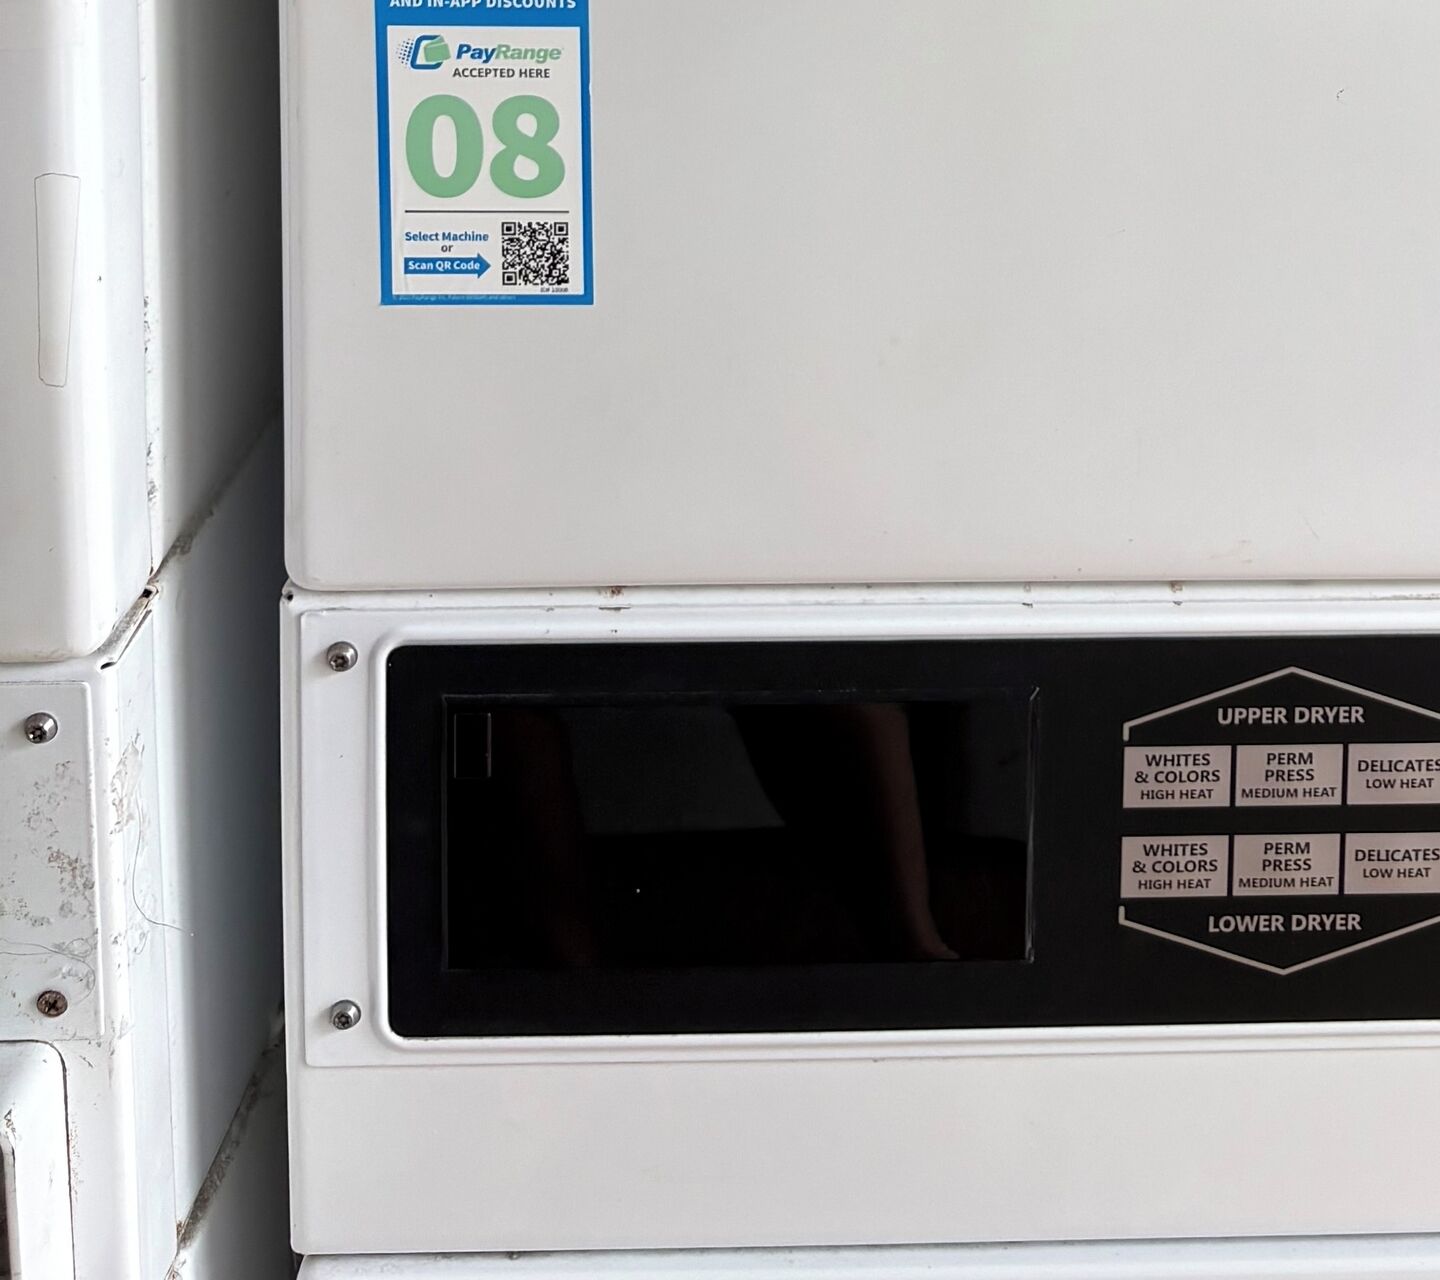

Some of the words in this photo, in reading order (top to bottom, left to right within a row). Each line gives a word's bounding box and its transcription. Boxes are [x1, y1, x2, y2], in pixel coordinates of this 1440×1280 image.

[456, 43, 562, 64] PayRange
[453, 68, 515, 78] ACCEPTED
[519, 68, 550, 79] HERE
[405, 94, 566, 198] 08
[405, 231, 439, 242] Select
[442, 232, 489, 242] Machine
[441, 244, 453, 253] or
[408, 260, 434, 271] Scan
[437, 260, 451, 272] QR
[454, 261, 480, 271] Code
[1217, 707, 1288, 725] UPPER
[1294, 706, 1365, 724] DRYER
[1145, 753, 1211, 767] WHITES
[1266, 752, 1314, 765] PERM
[1134, 771, 1149, 784] &
[1153, 770, 1221, 784] COLORS
[1264, 768, 1315, 782] PRESS
[1365, 778, 1397, 790] LOW
[1399, 777, 1435, 789] HEAT
[1140, 789, 1176, 800] HIGH
[1179, 788, 1214, 800] HEAT
[1241, 788, 1300, 799] MEDIUM
[1302, 787, 1337, 798] HEAT
[1143, 842, 1208, 856] WHITES
[1264, 842, 1311, 855] PERM
[1355, 848, 1440, 862] DELICATES
[1132, 861, 1147, 873] &
[1151, 859, 1218, 873] COLORS
[1262, 858, 1312, 872] PRESS
[1363, 868, 1394, 879] LOW
[1397, 867, 1431, 879] HEAT
[1137, 879, 1174, 890] HIGH
[1177, 878, 1212, 889] HEAT
[1238, 877, 1297, 888] MEDIUM
[1299, 876, 1335, 888] HEAT
[1208, 915, 1285, 932] LOWER
[1291, 914, 1362, 931] DRYER
